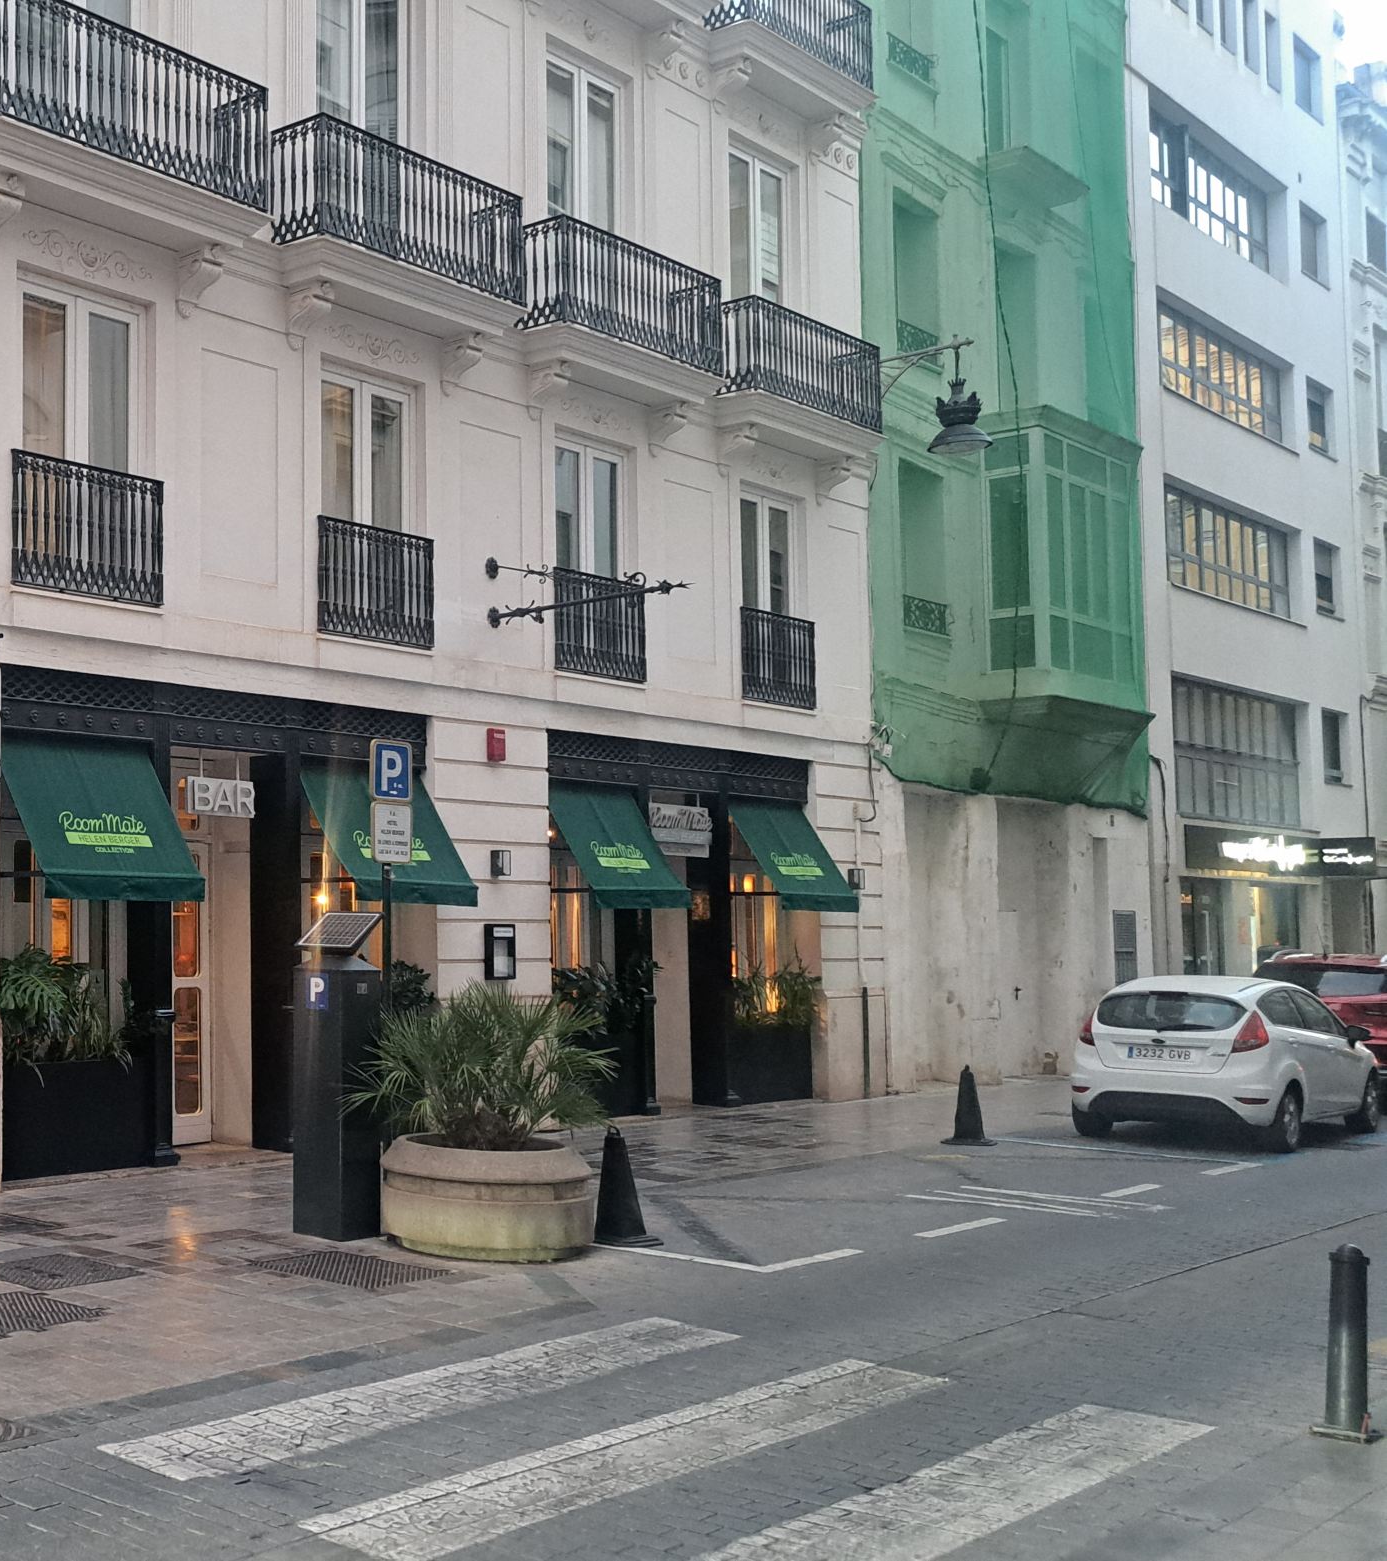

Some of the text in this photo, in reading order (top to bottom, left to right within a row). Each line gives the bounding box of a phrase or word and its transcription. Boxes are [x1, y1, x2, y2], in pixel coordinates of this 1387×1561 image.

[381, 750, 403, 791] P
[193, 780, 255, 817] BAR
[77, 834, 141, 845] HELEN BERGER
[94, 846, 135, 854] COLLECTION
[310, 977, 325, 1002] P
[1135, 1047, 1191, 1060] 3232 GVB
